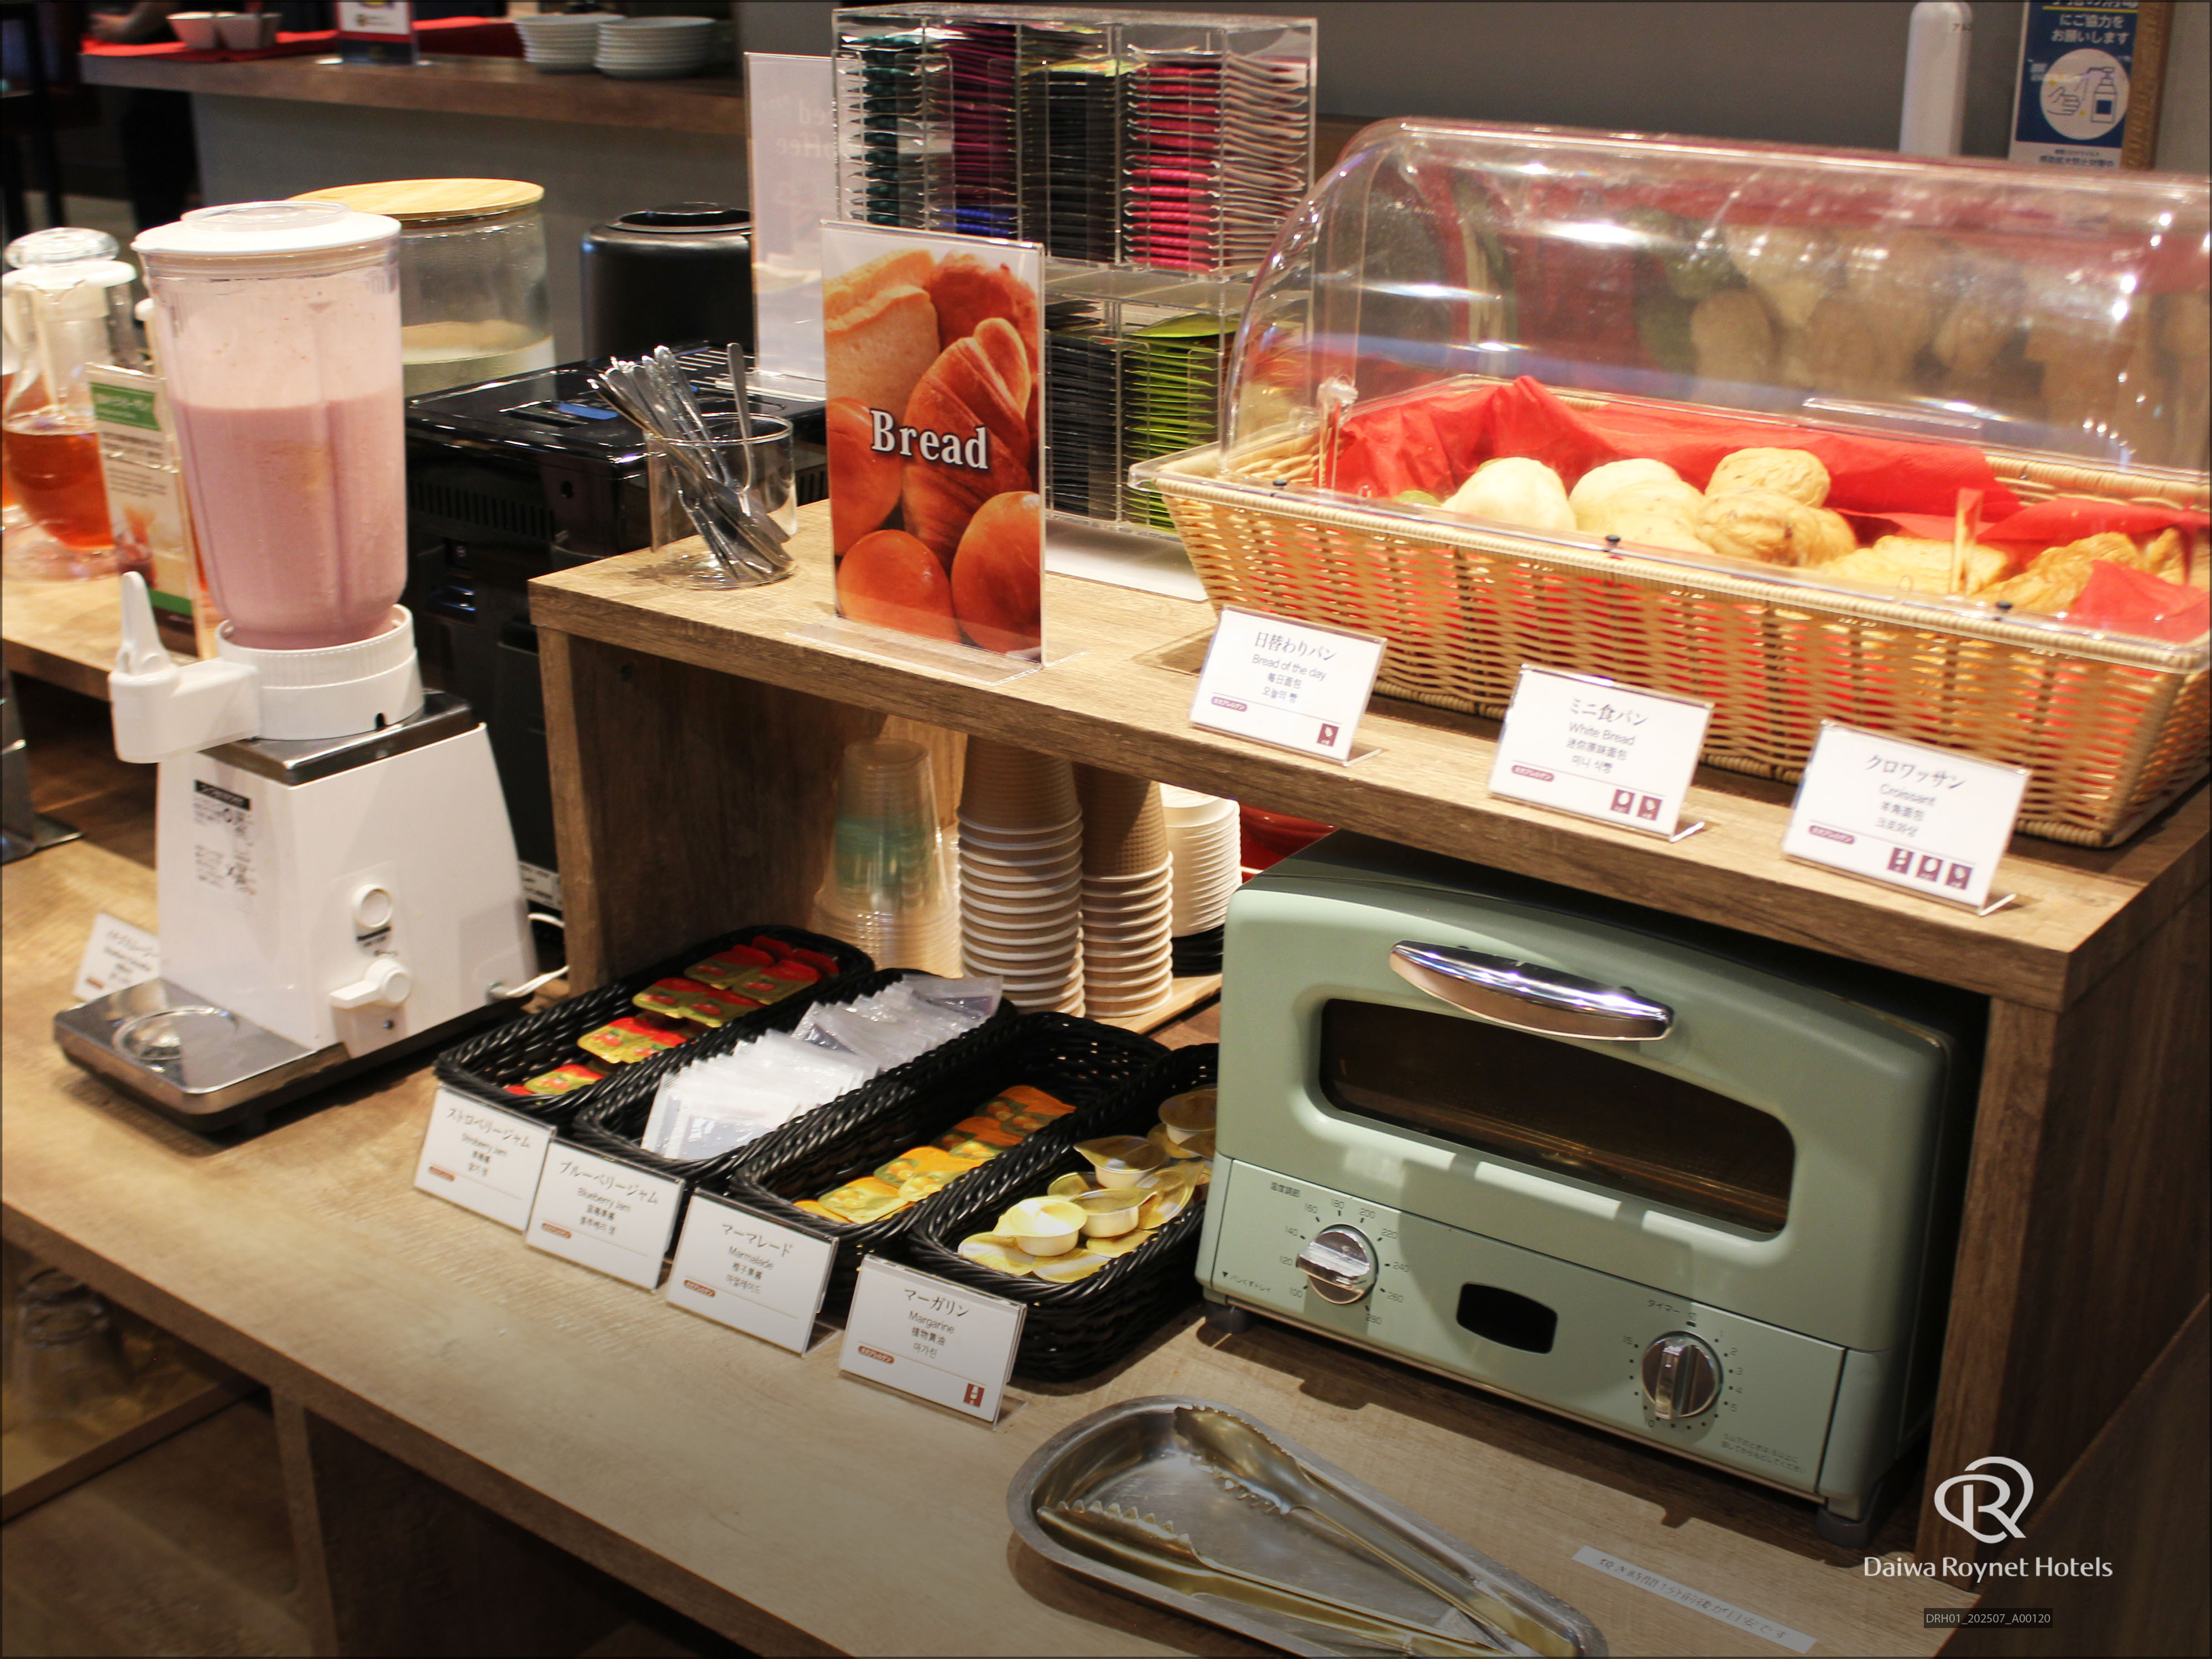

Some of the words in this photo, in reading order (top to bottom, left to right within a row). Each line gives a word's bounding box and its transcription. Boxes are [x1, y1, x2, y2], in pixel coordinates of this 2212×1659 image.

[2051, 29, 2129, 45] お願いします
[870, 408, 989, 470] Bread
[1254, 631, 1338, 661] 日替わりパン
[1252, 655, 1279, 669] Bread
[1281, 660, 1291, 671] of
[1292, 662, 1307, 675] the
[1309, 667, 1327, 681] day
[1569, 698, 1648, 726] ミニ食パン
[1569, 722, 1599, 737] White
[1602, 729, 1636, 745] Bread
[1865, 754, 1966, 789] クロワッサン
[1880, 784, 1937, 806] Croissant
[447, 1108, 530, 1147] ストロベリージャム
[559, 1161, 658, 1204] ブルーベリージャム
[578, 1187, 614, 1209] Blueberry
[1305, 1203, 1318, 1214] 160
[1331, 1199, 1345, 1209] 180
[1359, 1207, 1375, 1219] 200
[722, 1222, 792, 1257] マーマレード
[1285, 1226, 1298, 1237] 140
[1381, 1228, 1397, 1239] 220
[728, 1245, 774, 1270] Marmalade
[1280, 1255, 1293, 1266] 120
[1393, 1261, 1409, 1272] 240
[904, 1288, 971, 1317] マーガリン
[1290, 1286, 1303, 1298] 100
[1647, 1299, 1681, 1313] タイマー
[908, 1310, 954, 1334] Margarine
[1597, 1557, 1790, 1640] 焼き時間1分前後が目安です
